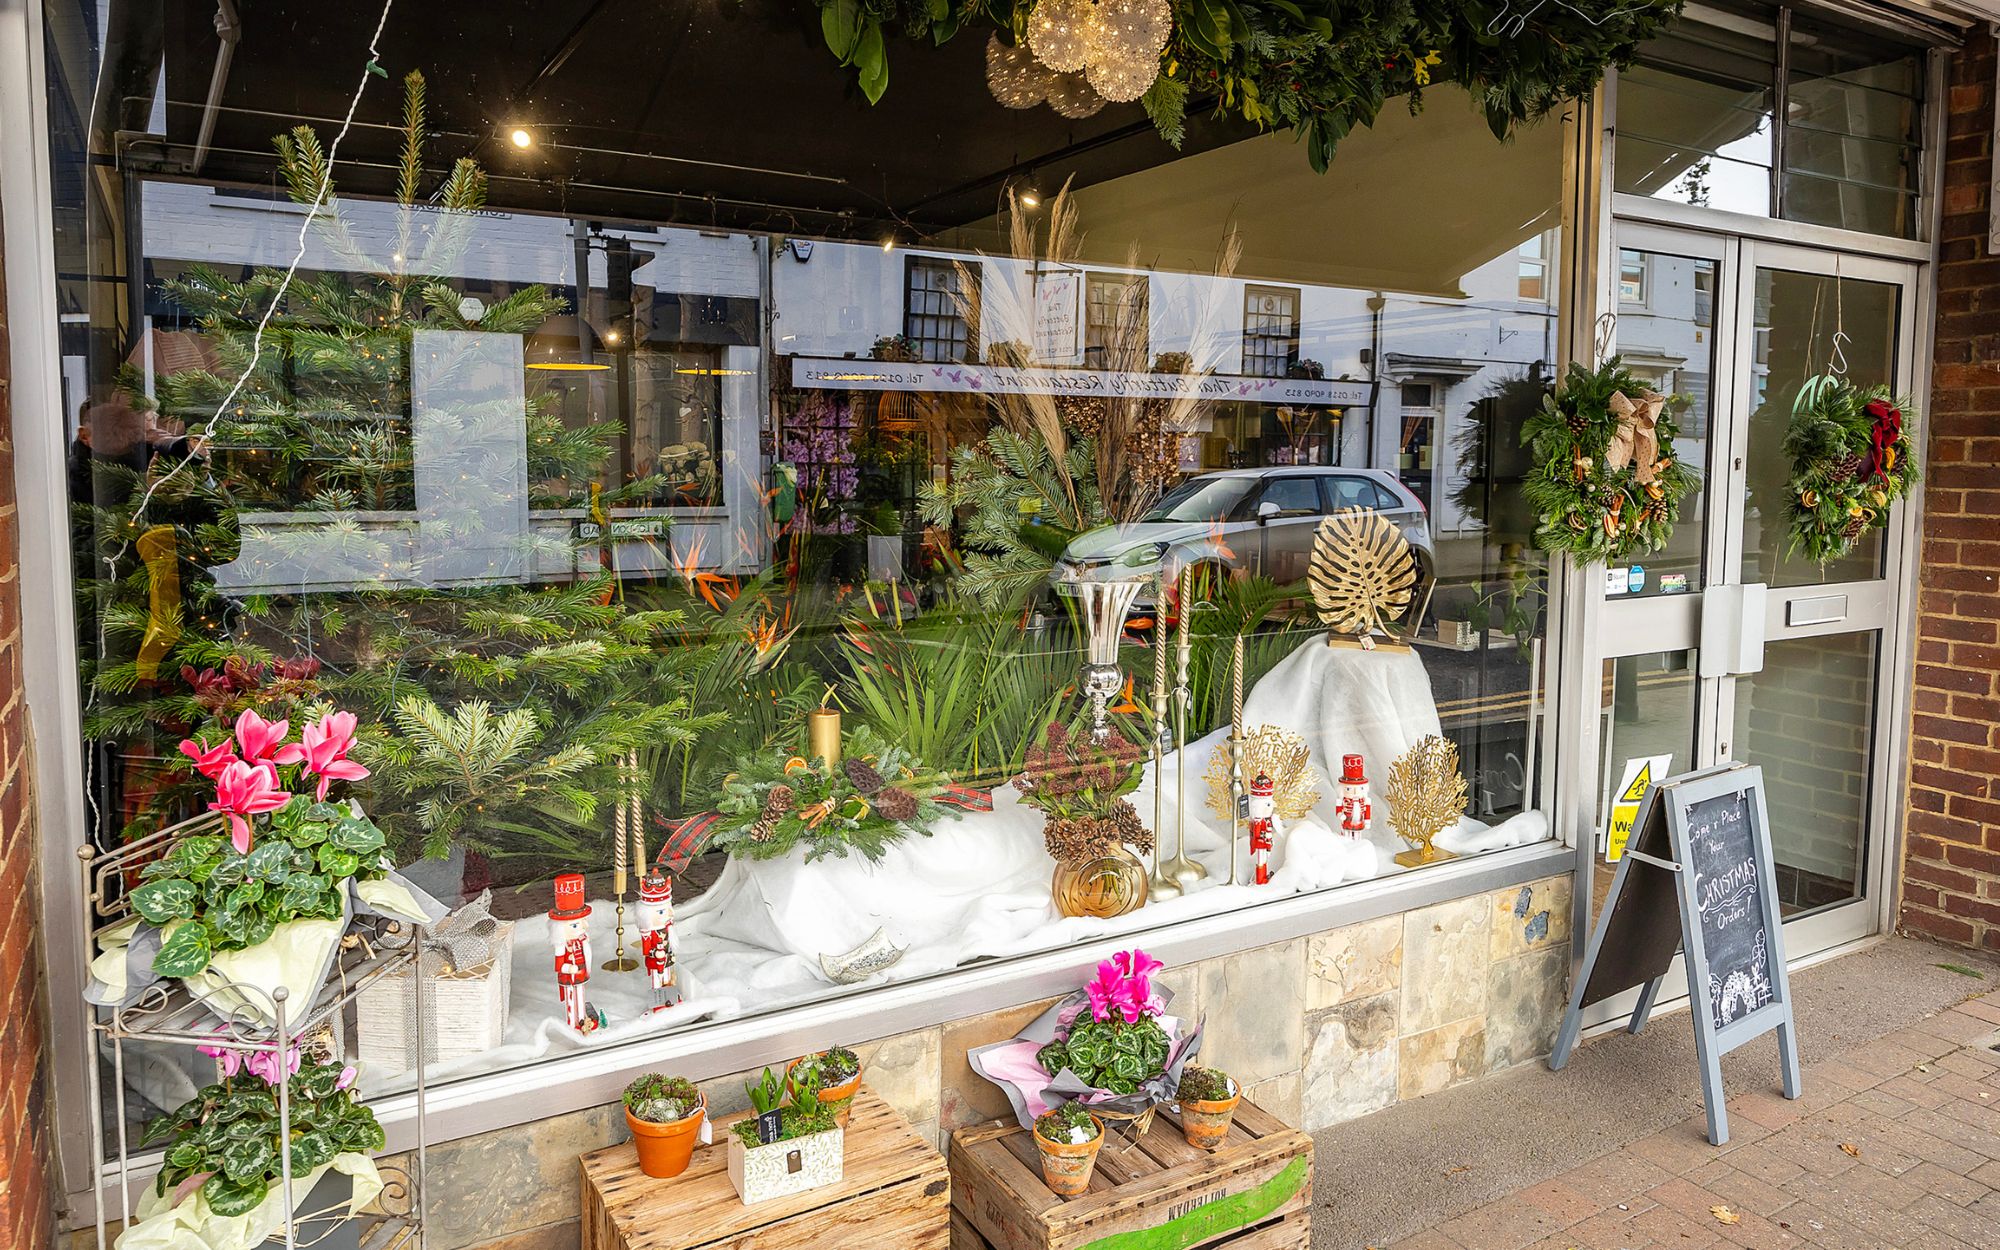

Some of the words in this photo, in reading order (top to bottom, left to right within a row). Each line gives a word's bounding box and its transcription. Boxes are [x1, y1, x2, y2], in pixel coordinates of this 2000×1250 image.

[1688, 823, 1710, 843] Come
[1721, 810, 1741, 826] Place
[1709, 839, 1724, 855] Your
[1694, 857, 1757, 912] CHRISTMAS
[1168, 1188, 1227, 1221] ROTTERDAM
